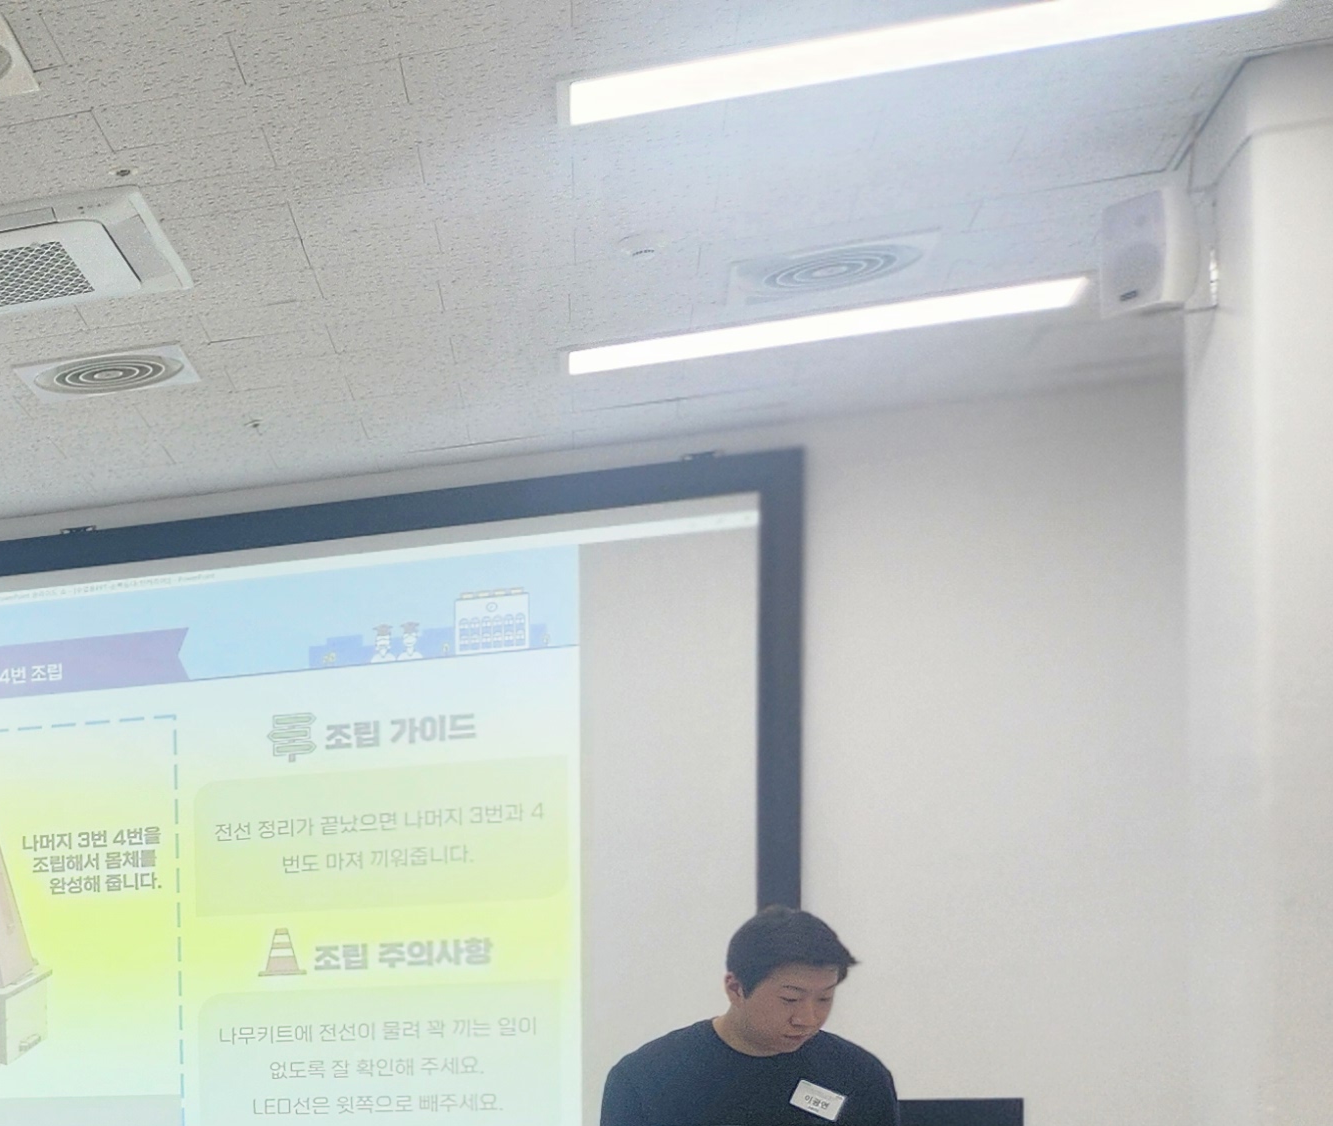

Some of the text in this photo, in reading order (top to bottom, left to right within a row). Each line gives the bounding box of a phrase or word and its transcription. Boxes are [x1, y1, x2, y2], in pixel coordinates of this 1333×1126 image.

[31, 663, 63, 682] 조립
[325, 713, 477, 750] 조립 가이드
[214, 802, 545, 842] 전선 정리가 끝났으면 나머지 3번과 4
[22, 826, 162, 852] 나머지 3번 4번을
[32, 849, 157, 873] 조립해서 몸체를
[282, 844, 475, 875] 번도 마져 끼워줍니다.
[50, 872, 162, 895] 완성해 줍니다.
[314, 937, 493, 971] 조립 주의사항
[219, 1016, 537, 1045] 나무키트에 전선이 물려 꽉 끼는 일이
[269, 1056, 485, 1080] 없도록 잘 확인해 주세요.
[252, 1096, 331, 1115] LED선은
[419, 1093, 504, 1112] 빼주세요.
